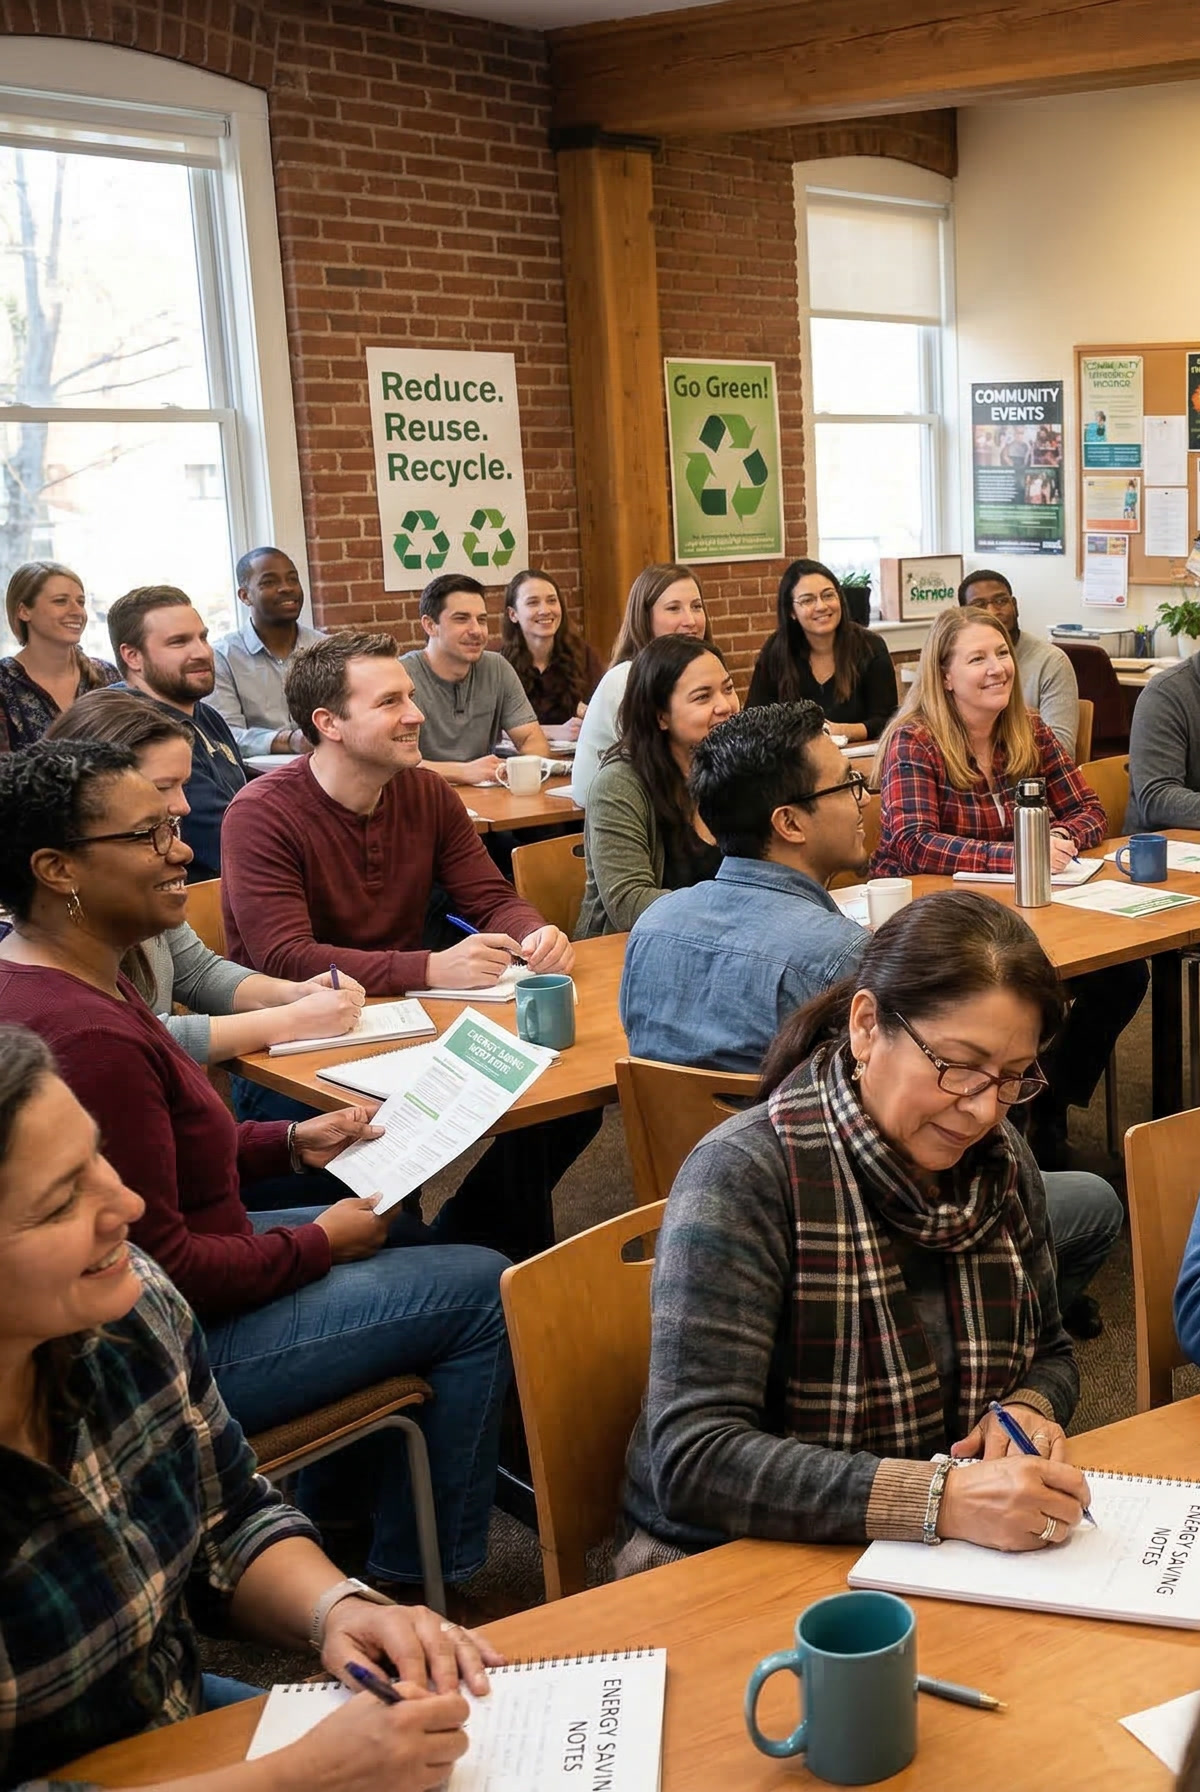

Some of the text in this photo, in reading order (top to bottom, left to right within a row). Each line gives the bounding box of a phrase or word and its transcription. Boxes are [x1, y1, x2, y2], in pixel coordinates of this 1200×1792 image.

[381, 371, 504, 403] Reduce.
[673, 375, 768, 400] Go Green!
[975, 388, 1059, 404] COMMUNITY
[384, 412, 489, 441] Reuse.
[991, 406, 1044, 421] EVENTS
[387, 453, 513, 487] Recycle.
[1142, 1527, 1172, 1566] NOTES
[1156, 1551, 1189, 1595] SAVING
[563, 1721, 588, 1772] NOTES
[592, 1678, 622, 1792] ENERGY SAVIN
